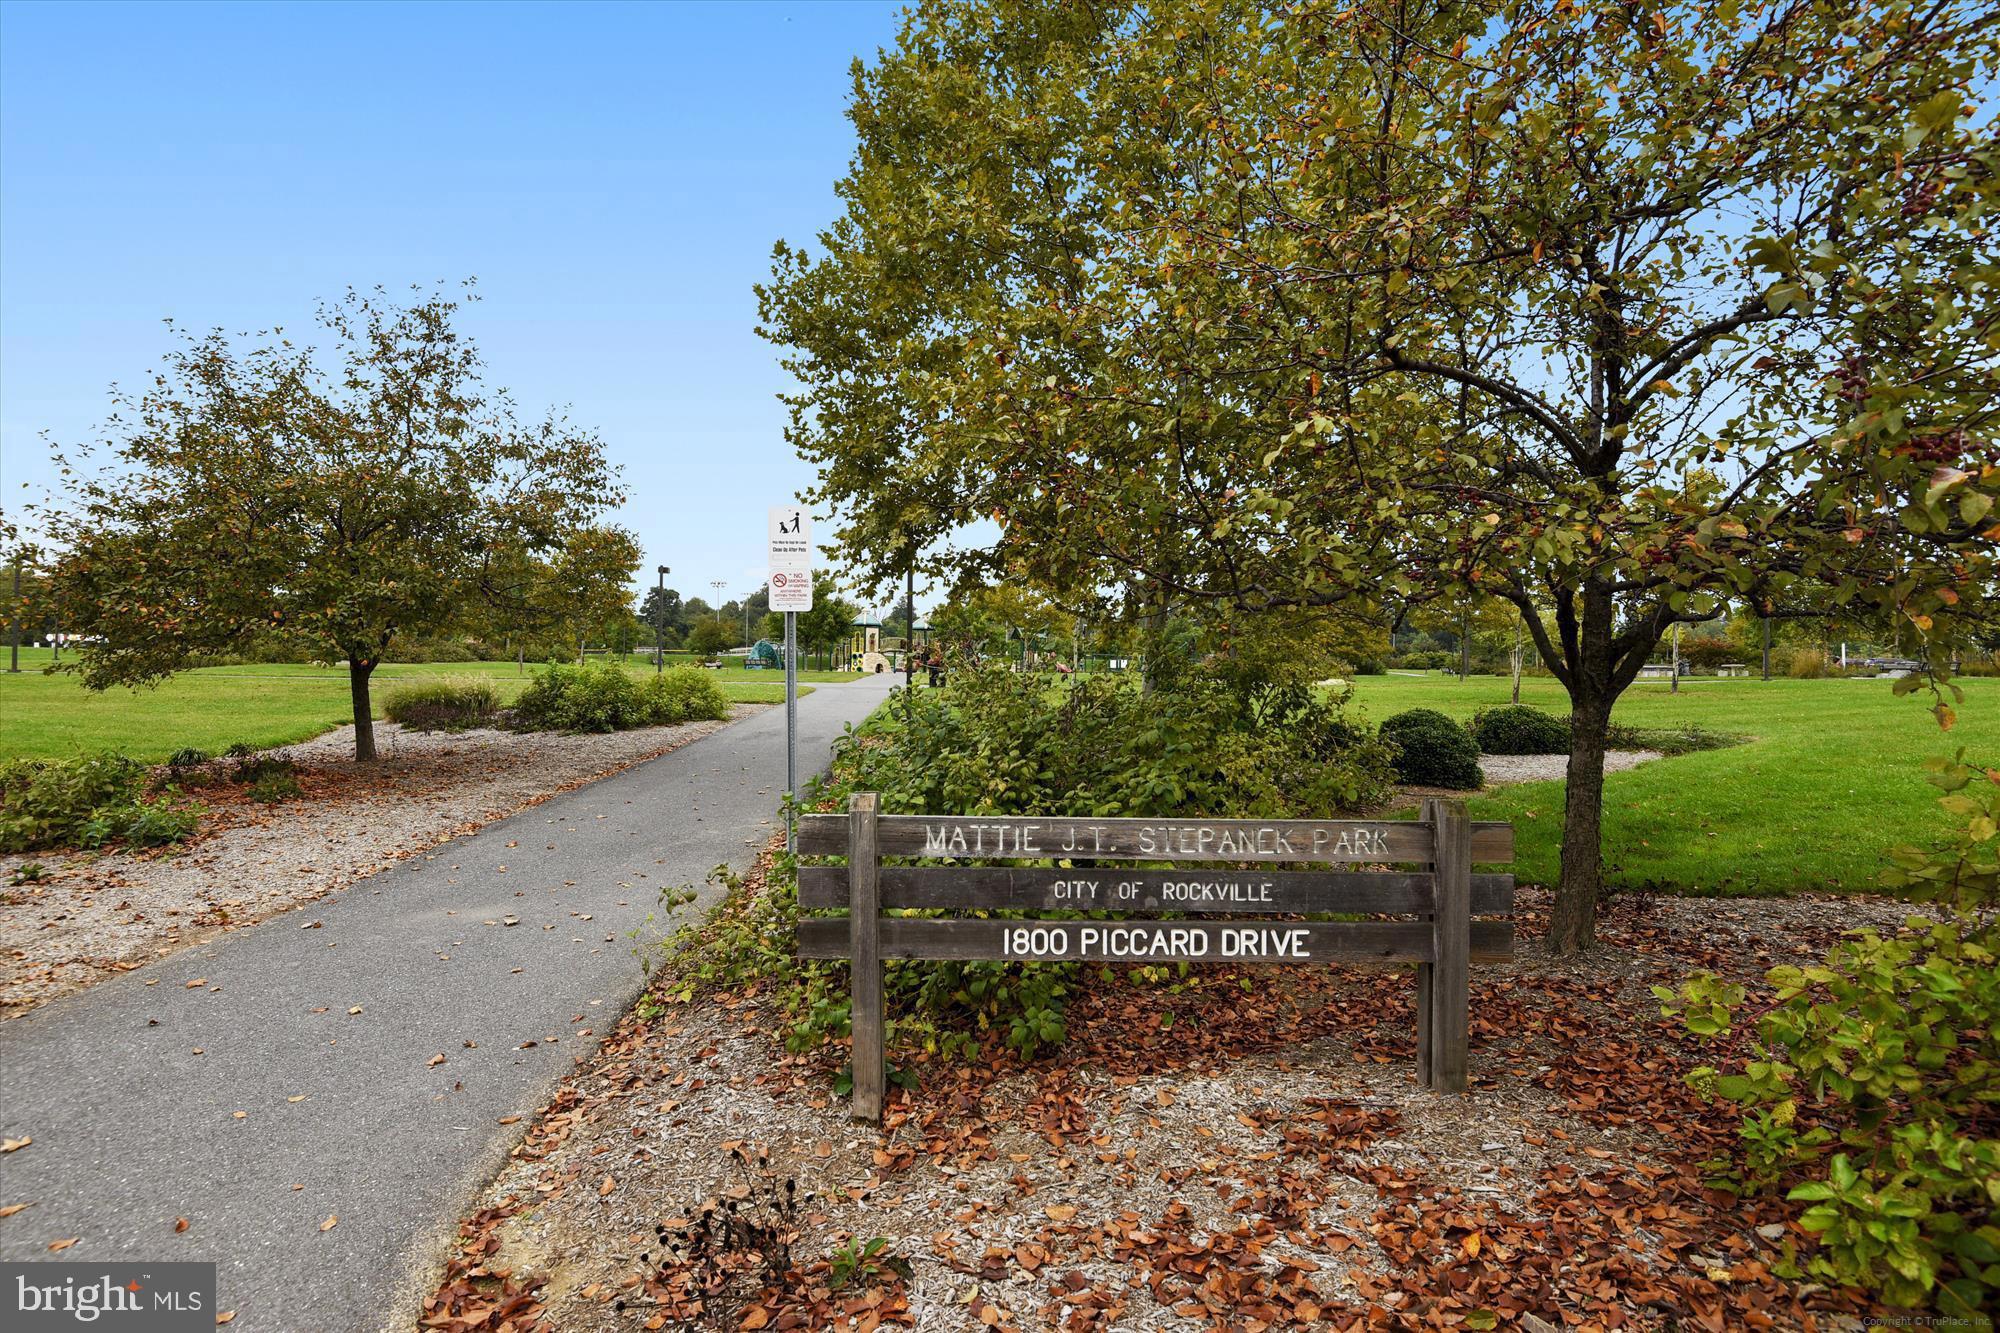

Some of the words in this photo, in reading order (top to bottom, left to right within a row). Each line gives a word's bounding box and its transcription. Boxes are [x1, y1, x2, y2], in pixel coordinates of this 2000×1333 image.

[925, 824, 1041, 851] MATTIE
[1061, 826, 1117, 852] J.T.
[1138, 826, 1294, 854] STEPANEK
[1313, 827, 1389, 855] PARK
[1054, 880, 1099, 899] CITY
[1118, 881, 1143, 900] OF
[1163, 882, 1273, 902] ROCKVILLE
[1003, 928, 1068, 956] 1800
[1080, 928, 1209, 956] PICCARD
[1221, 929, 1311, 957] DRIVE
